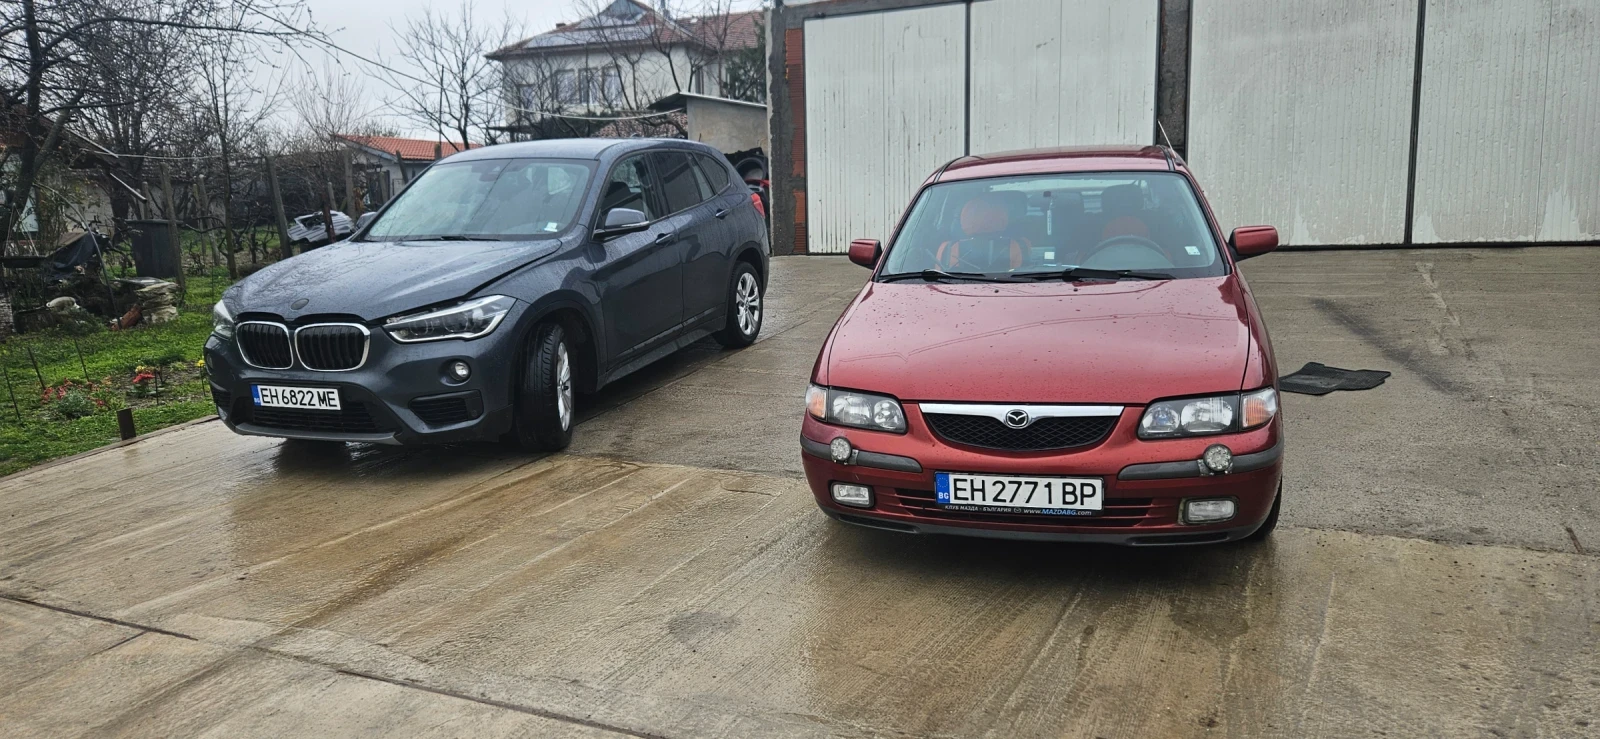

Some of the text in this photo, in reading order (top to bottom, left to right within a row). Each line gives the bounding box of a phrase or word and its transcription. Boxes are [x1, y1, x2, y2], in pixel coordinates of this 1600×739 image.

[260, 387, 338, 407] EH 6822 ME
[953, 478, 1097, 505] EH 2771 BP
[1023, 508, 1092, 516] www.MAZDABG.com
